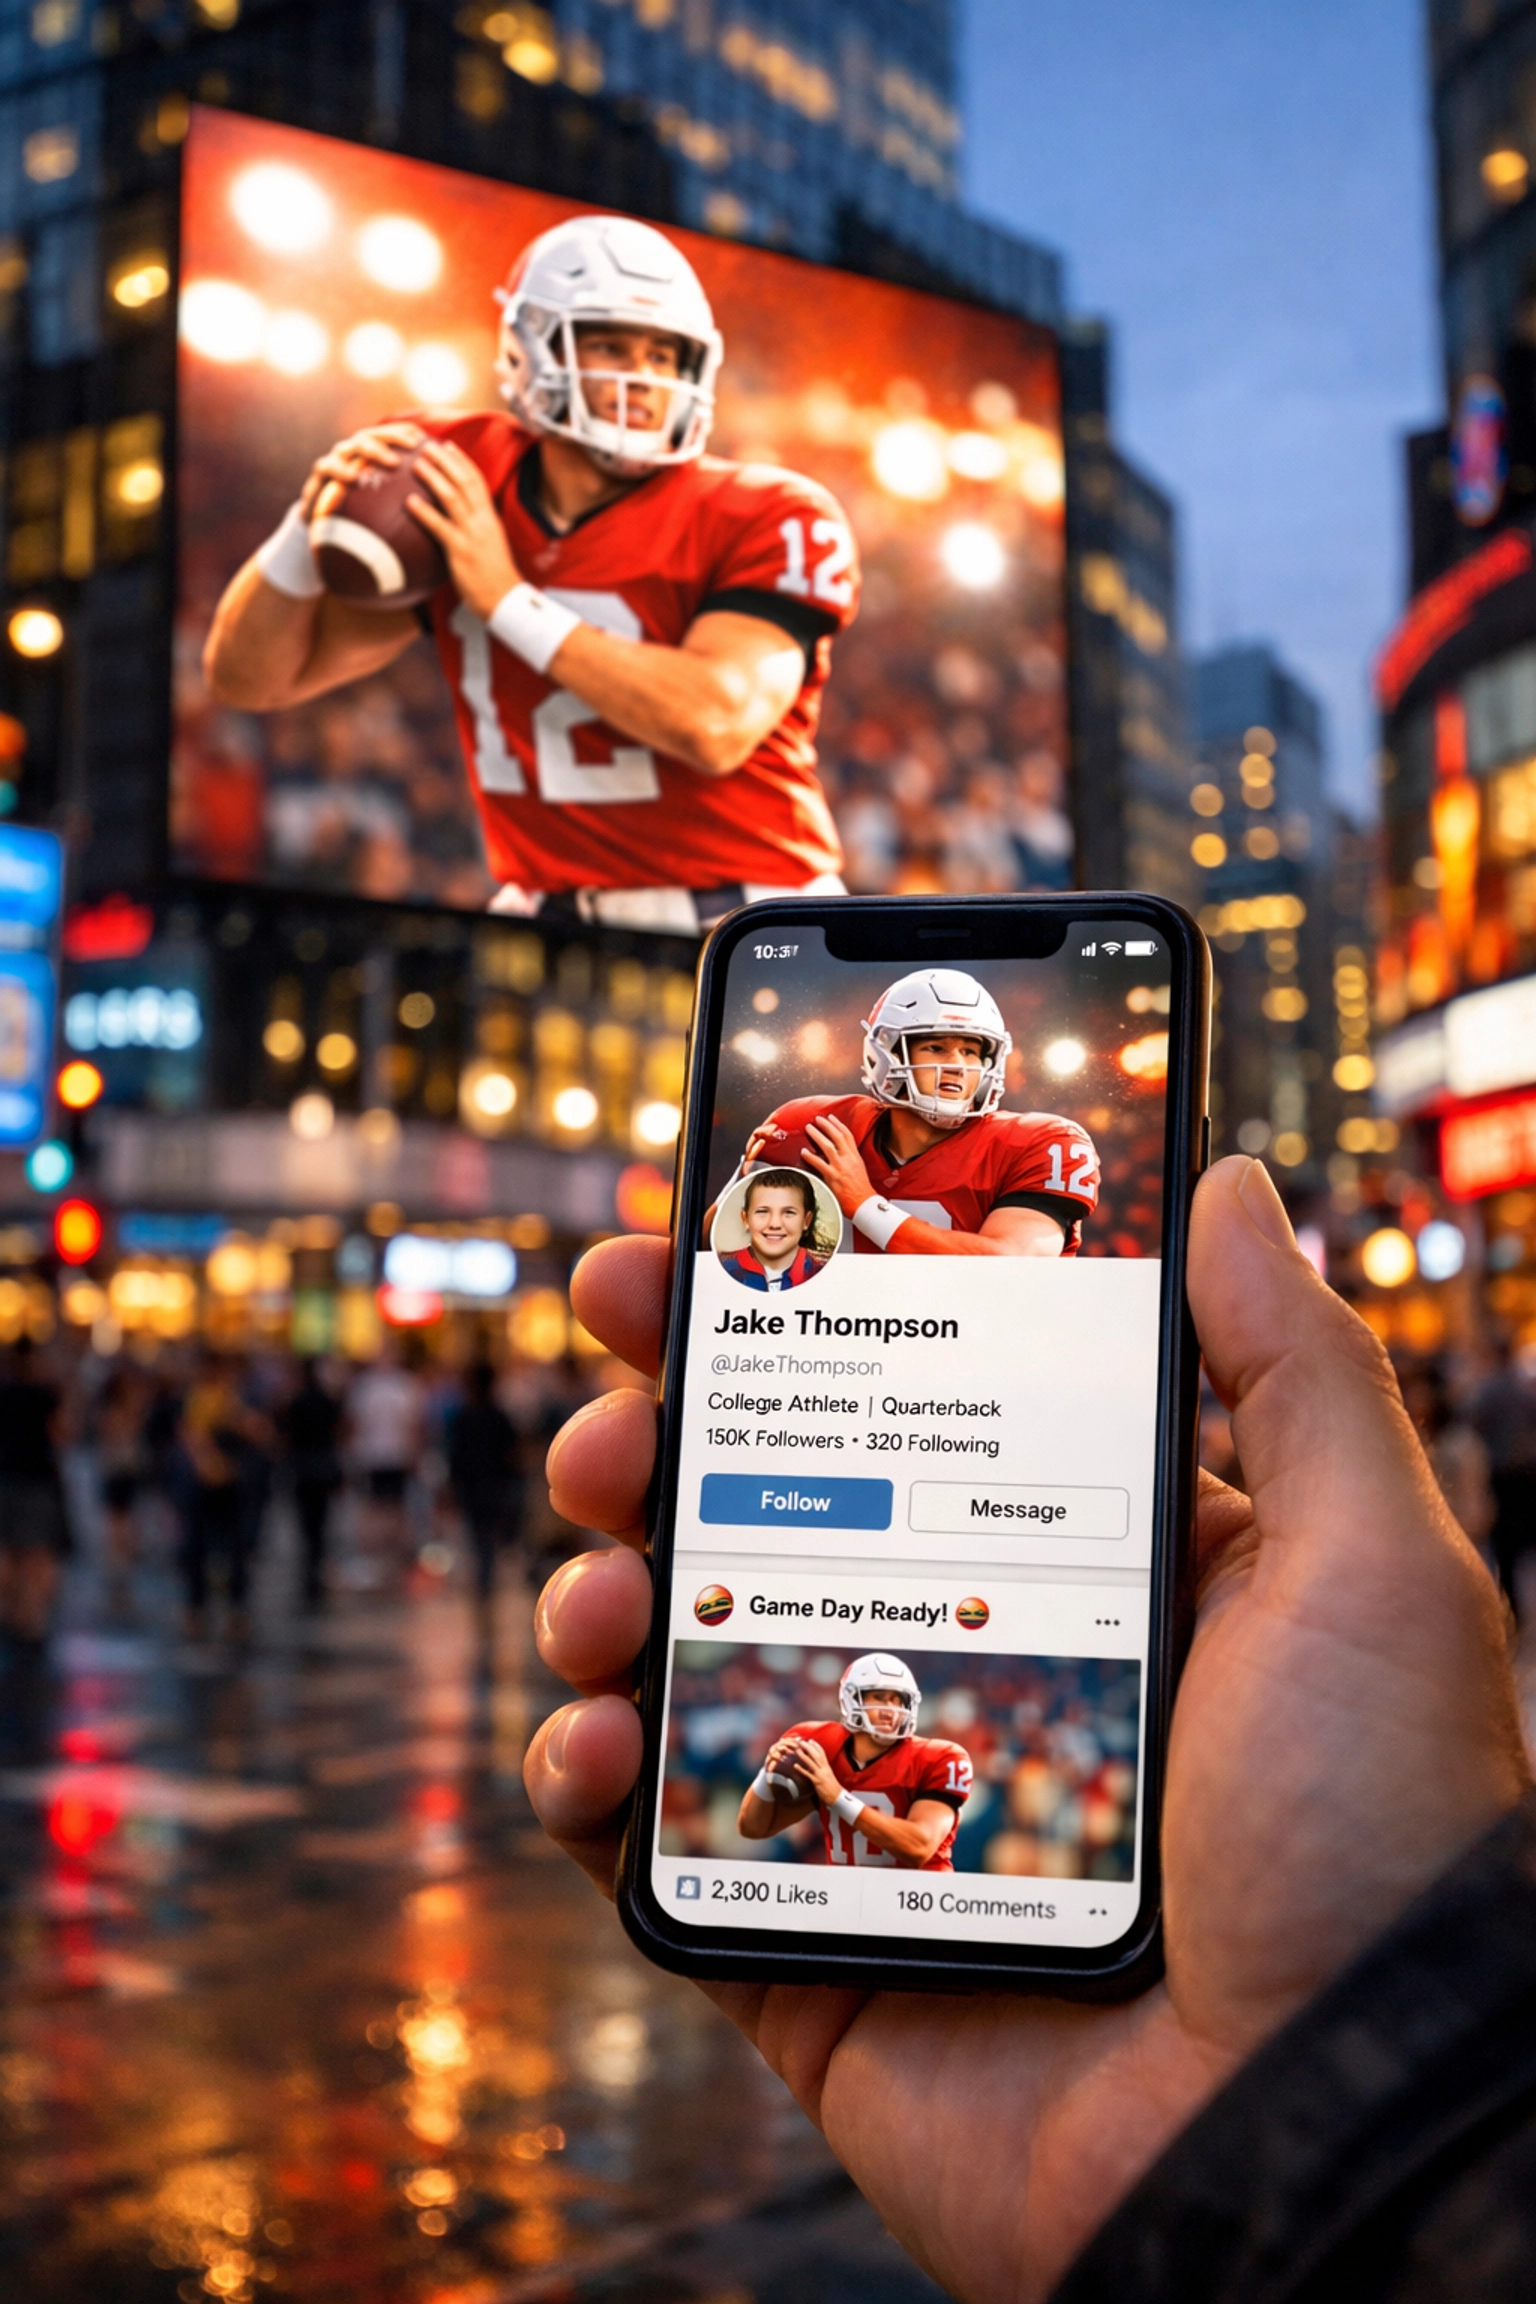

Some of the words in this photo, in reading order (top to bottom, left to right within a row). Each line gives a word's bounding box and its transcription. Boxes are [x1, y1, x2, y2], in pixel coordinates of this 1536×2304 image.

[776, 518, 853, 606] 12
[450, 587, 661, 804] 12
[1044, 1143, 1095, 1199] 12
[713, 1308, 785, 1335] Jake
[794, 1309, 959, 1344] Thompson
[710, 1353, 883, 1379] @JakeThompson
[707, 1391, 783, 1416] College
[787, 1394, 859, 1414] Athlete
[881, 1396, 1002, 1418] Quarterback
[706, 1427, 751, 1447] 150K
[755, 1429, 845, 1450] Followers
[865, 1432, 903, 1452] 320
[908, 1433, 1000, 1459] Following
[760, 1490, 832, 1512] Follow
[970, 1498, 1067, 1524] Message
[749, 1594, 815, 1618] Game
[821, 1598, 865, 1623] Day
[870, 1600, 948, 1628] Ready!
[945, 1760, 973, 1793] 12
[711, 1880, 770, 1903] 2,300
[776, 1884, 829, 1906] Likes
[897, 1890, 933, 1913] 180
[939, 1893, 1057, 1920] Comments
